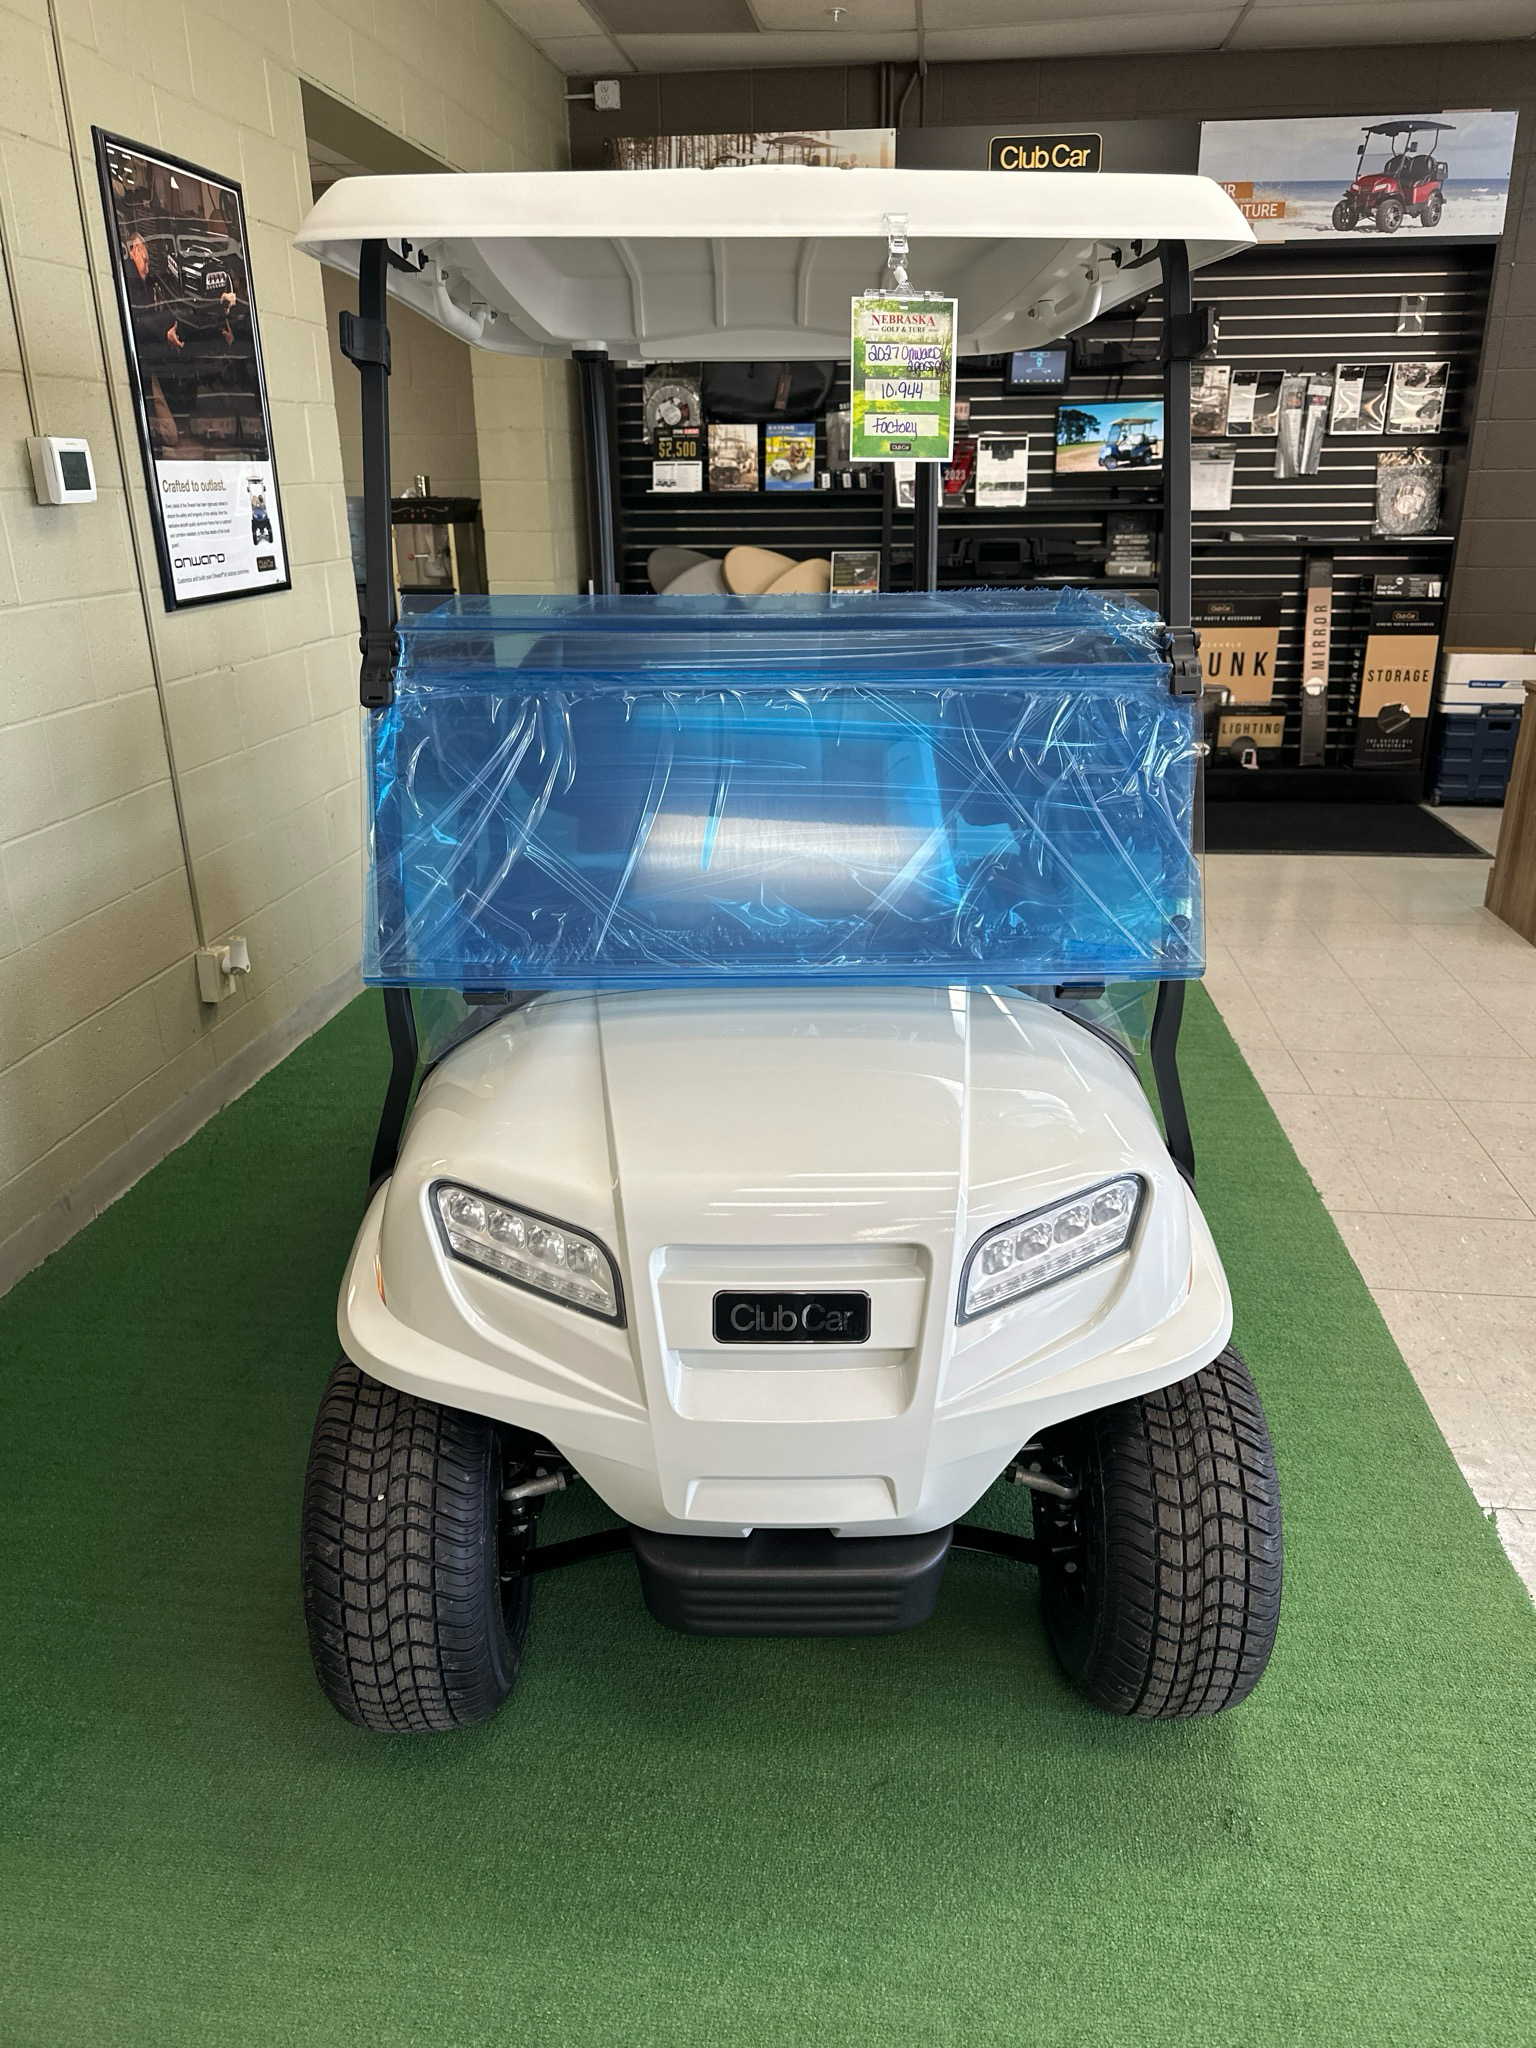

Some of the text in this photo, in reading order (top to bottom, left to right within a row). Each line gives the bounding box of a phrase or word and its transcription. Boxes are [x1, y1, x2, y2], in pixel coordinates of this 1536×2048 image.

[1000, 144, 1091, 169] Club Car
[871, 314, 936, 326] NEBRASKA
[868, 345, 899, 361] 2027
[658, 441, 697, 459] $2,500
[944, 469, 967, 480] 2023
[162, 479, 227, 493] Crafted to outlast.
[1311, 605, 1328, 670] MIRROR
[1208, 651, 1269, 677] UNK
[1367, 669, 1430, 682] STORAGE
[1222, 722, 1280, 734] LIGHTING
[730, 1303, 853, 1332] Club Car
